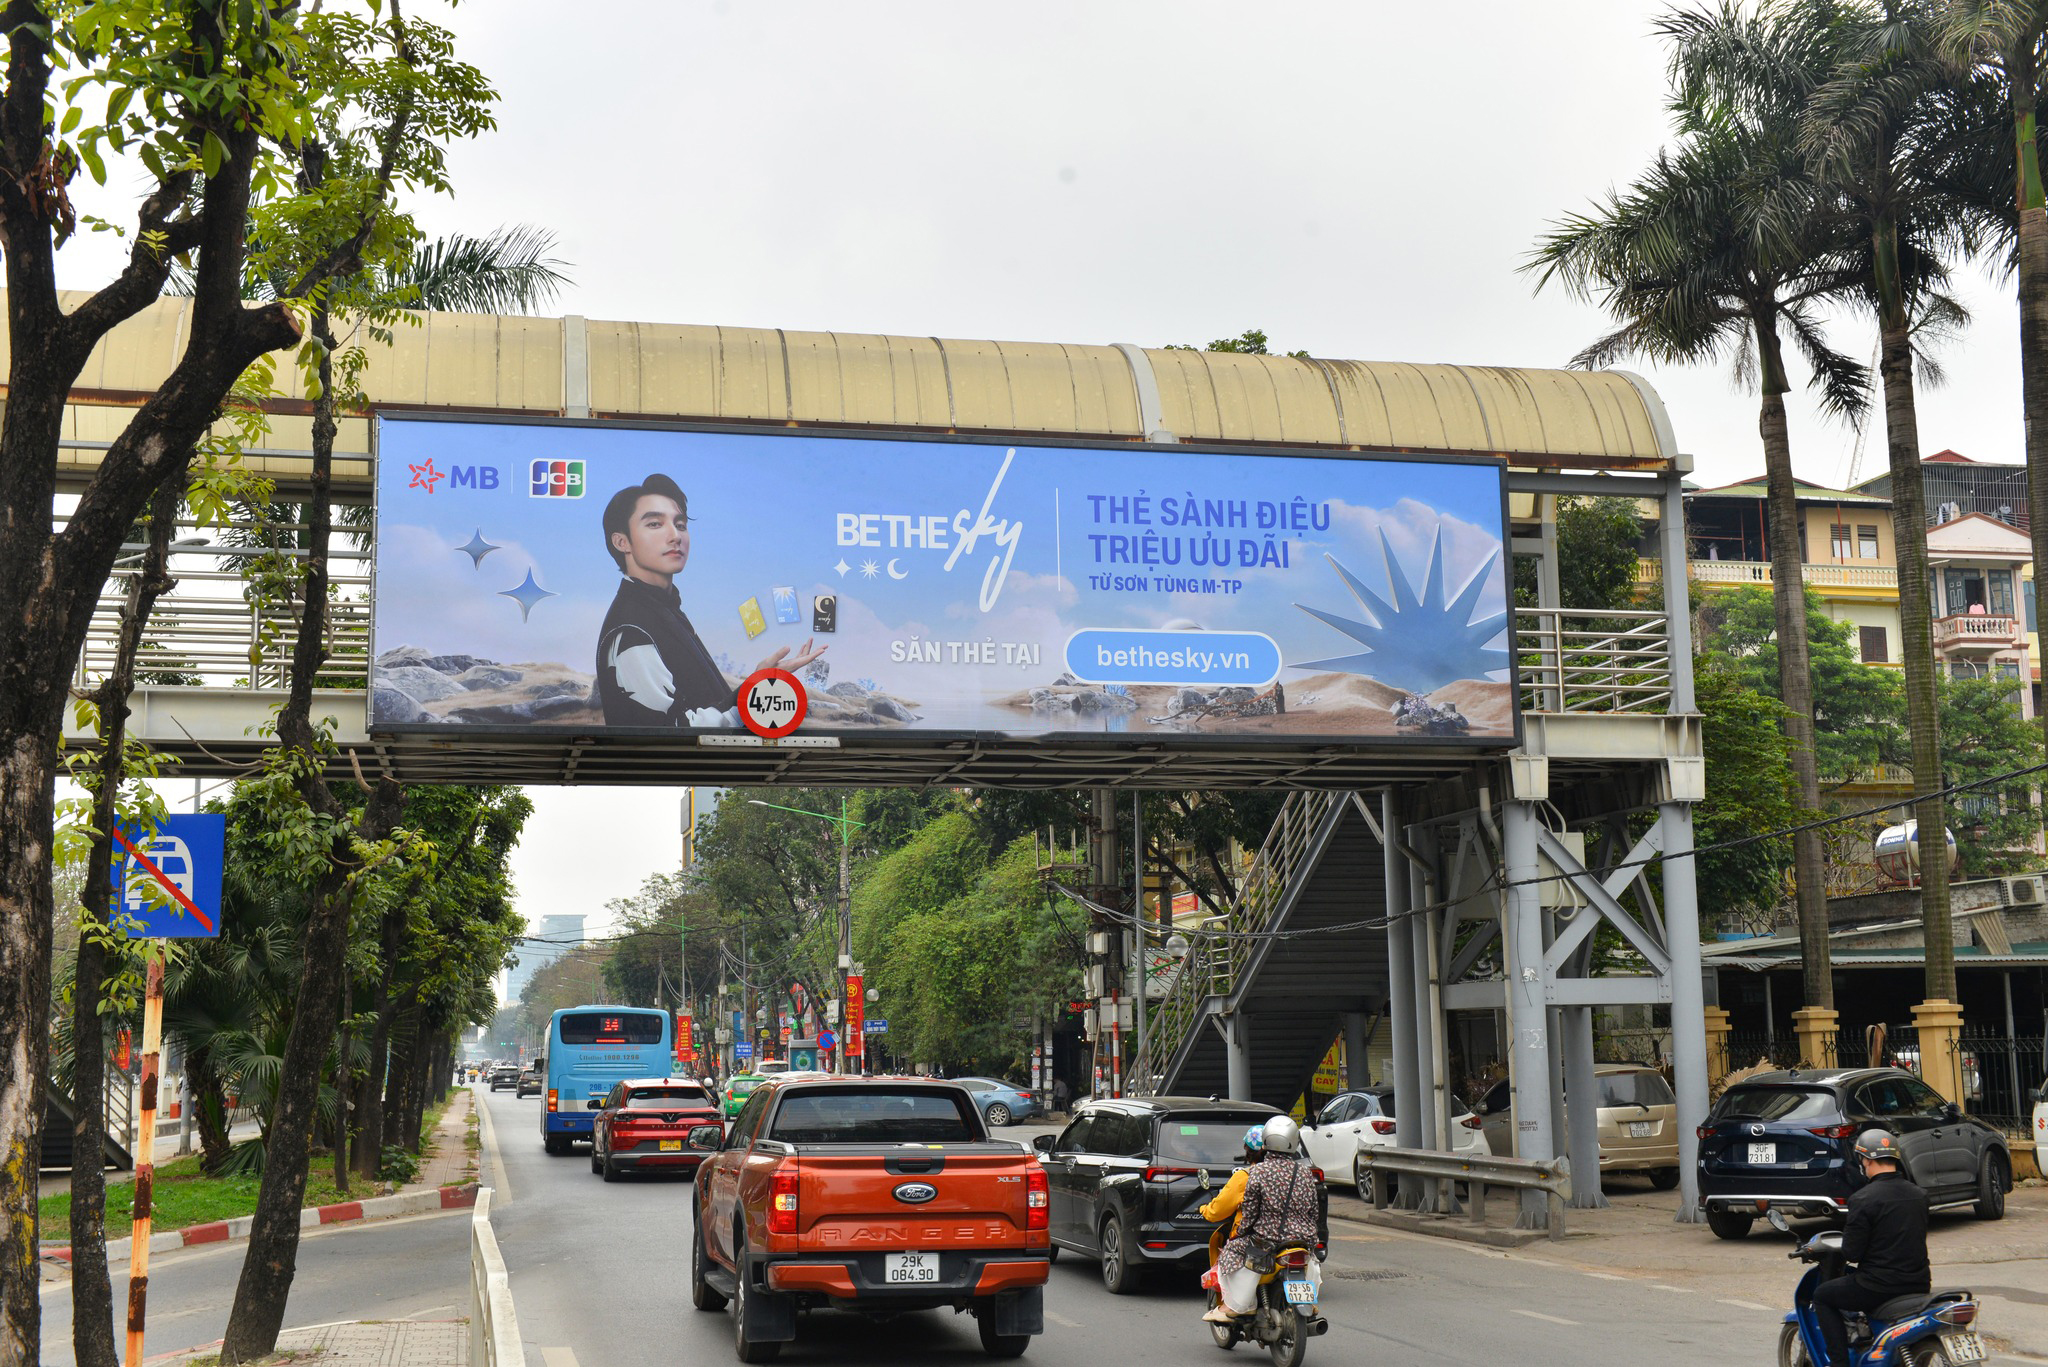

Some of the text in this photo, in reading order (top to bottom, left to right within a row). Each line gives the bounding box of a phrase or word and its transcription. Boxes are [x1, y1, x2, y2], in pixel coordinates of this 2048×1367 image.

[450, 465, 500, 490] MB
[532, 472, 582, 486] JCB
[1087, 488, 1330, 538] THẺ SÀNH ĐIỆU
[1087, 528, 1290, 572] TRIỆU ƯU ĐÃI
[1089, 572, 1243, 594] TỪ SƠN TÙNG M-TP
[890, 636, 1041, 670] SĂN THẺ TẠI
[1096, 644, 1251, 673] bethesky.vn
[1315, 1077, 1335, 1085] CAY
[1754, 1143, 1769, 1153] 30F
[1749, 1153, 1775, 1163] 731.81
[997, 1175, 1022, 1183] XLS
[905, 1187, 927, 1199] Ford
[819, 1224, 1008, 1242] RANGER
[901, 1255, 924, 1268] 29K
[891, 1268, 934, 1282] 084.90
